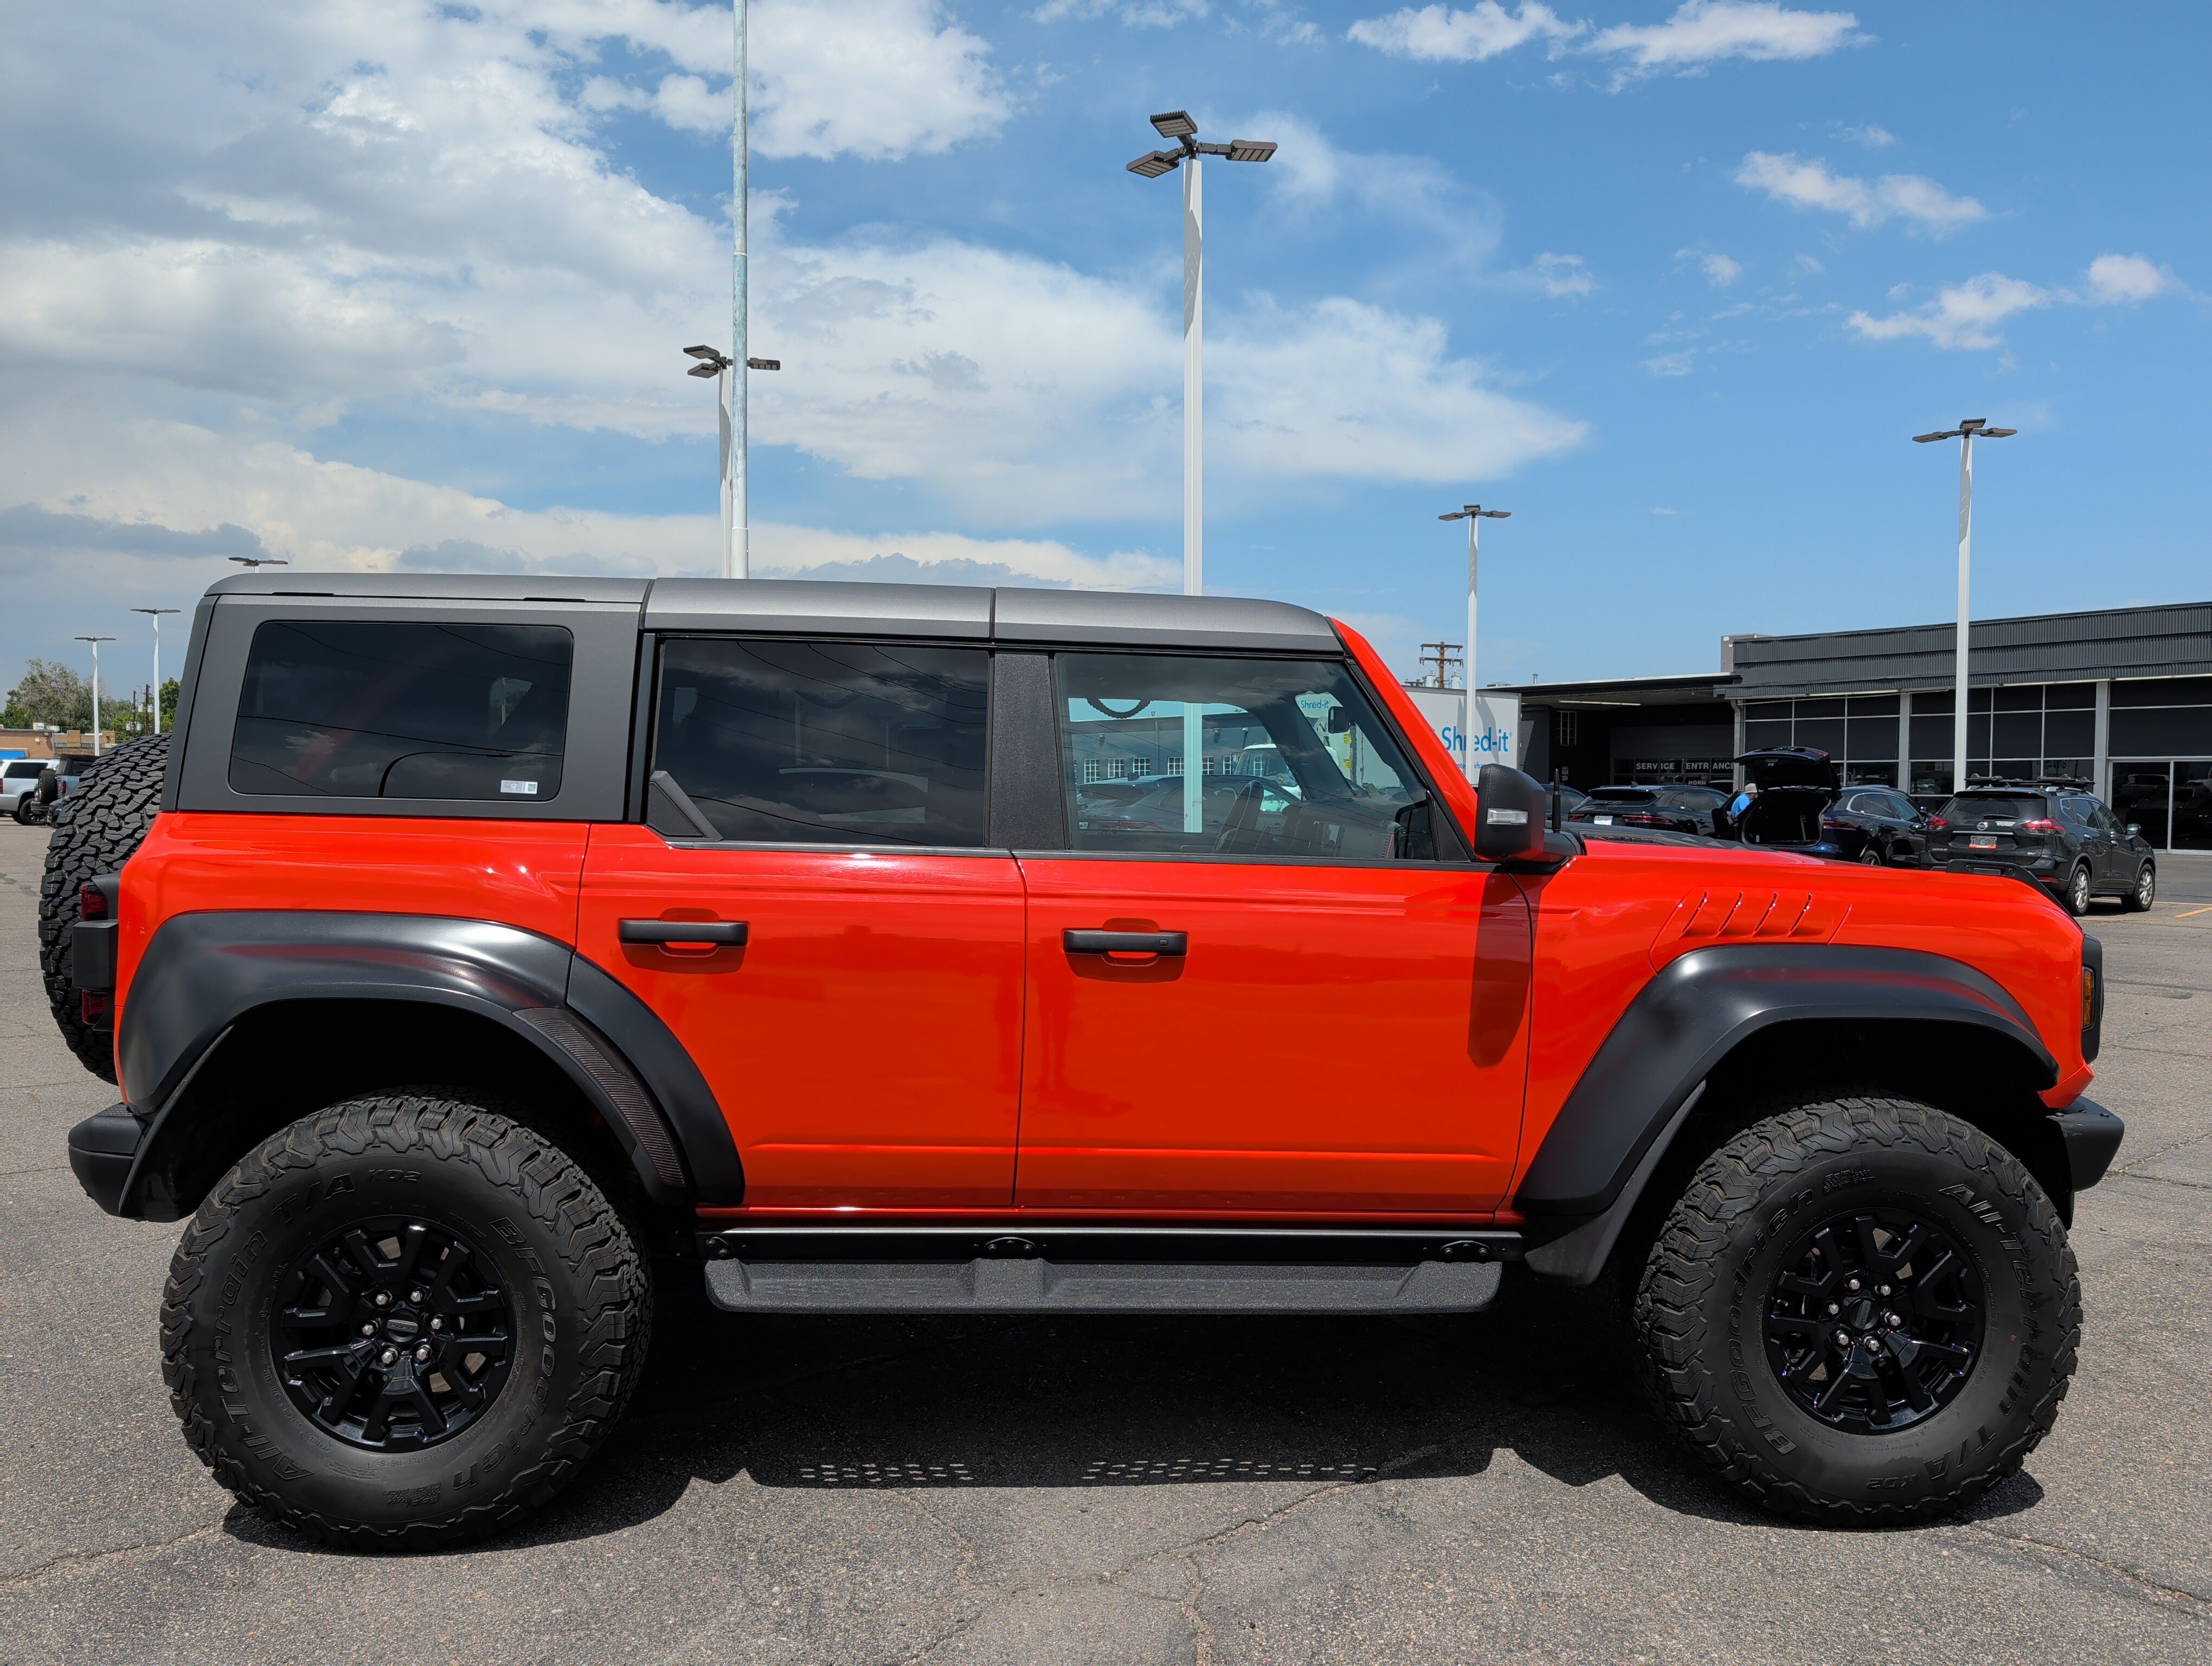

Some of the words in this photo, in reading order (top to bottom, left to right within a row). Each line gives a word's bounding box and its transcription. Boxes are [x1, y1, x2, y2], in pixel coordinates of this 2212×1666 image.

[213, 1230, 314, 1481] All-Terrain
[452, 1216, 557, 1490] BFGoodrich
[1729, 1189, 1815, 1456] BFGoodrich
[1938, 1184, 2035, 1417] All-Terrain
